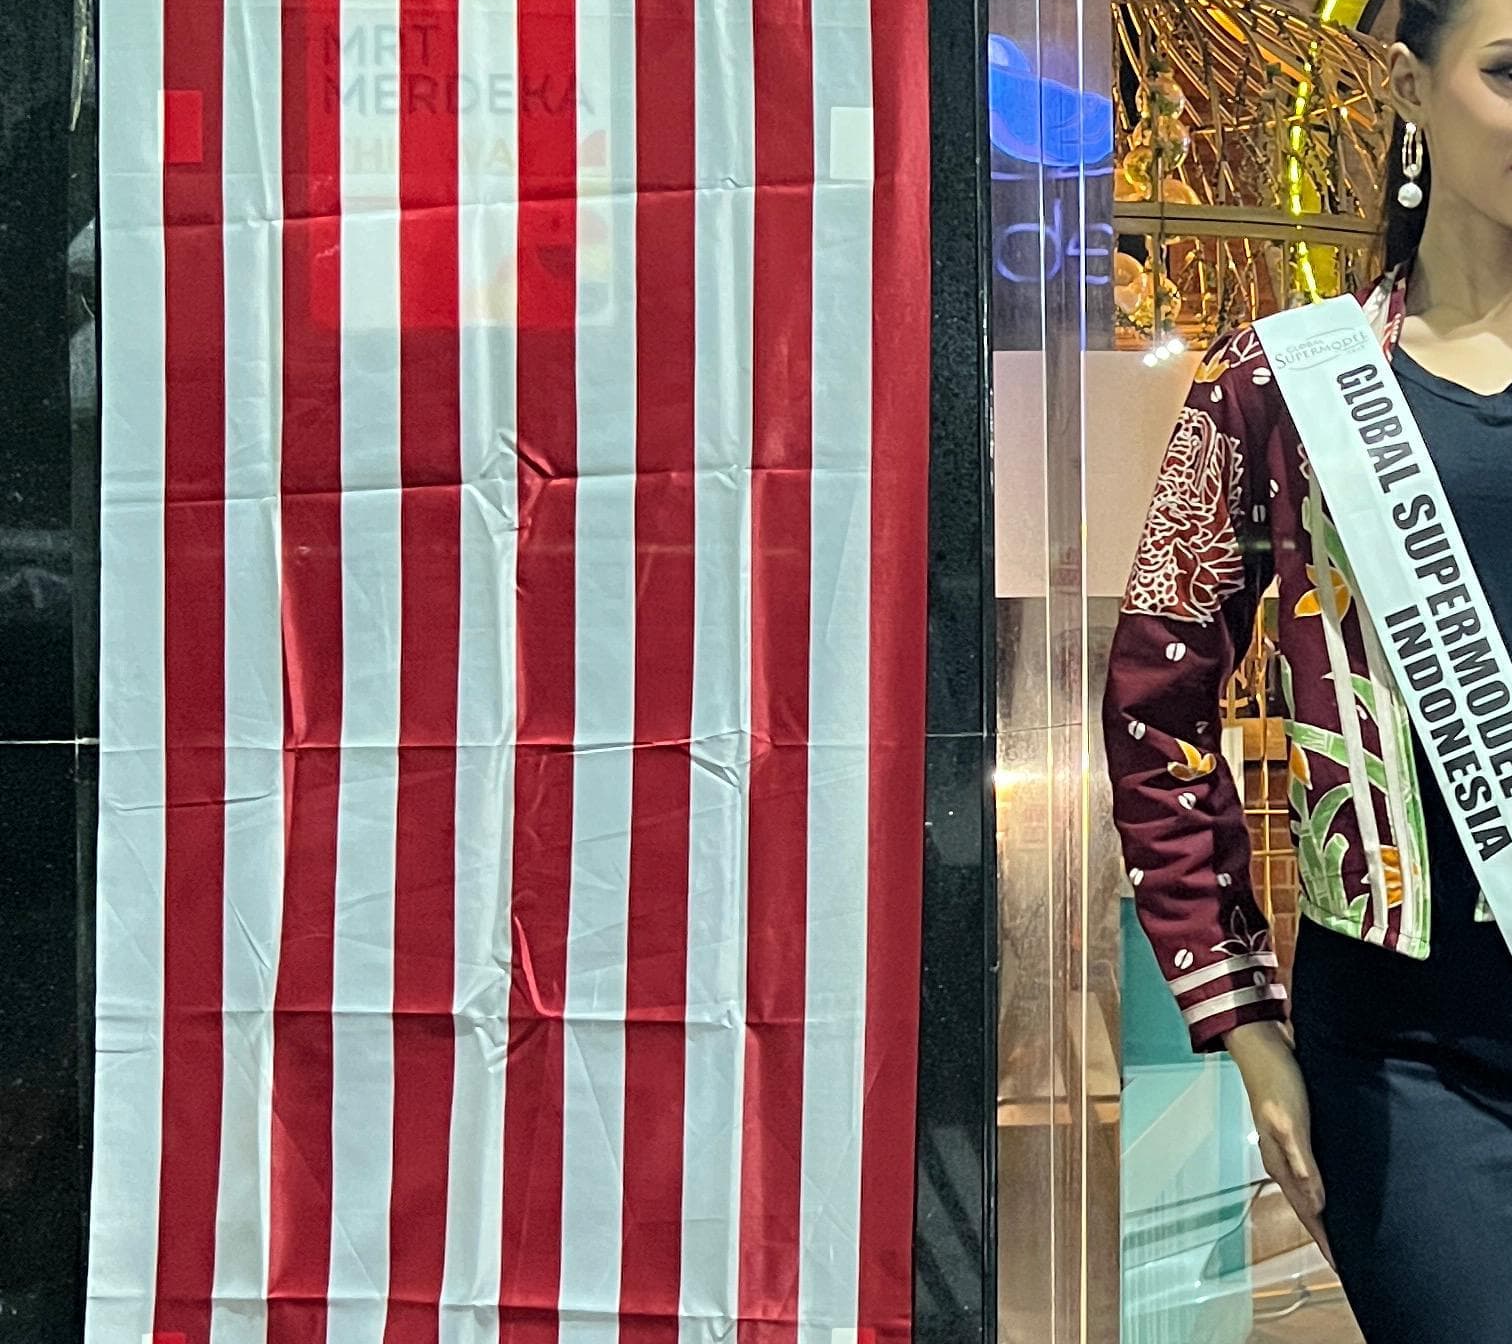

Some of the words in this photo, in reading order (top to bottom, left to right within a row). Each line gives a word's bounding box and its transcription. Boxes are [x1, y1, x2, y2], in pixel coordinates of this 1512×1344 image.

[323, 72, 597, 117] MERDEKA
[1336, 363, 1421, 495] GLOBAL
[1384, 603, 1512, 863] INDONESIA
